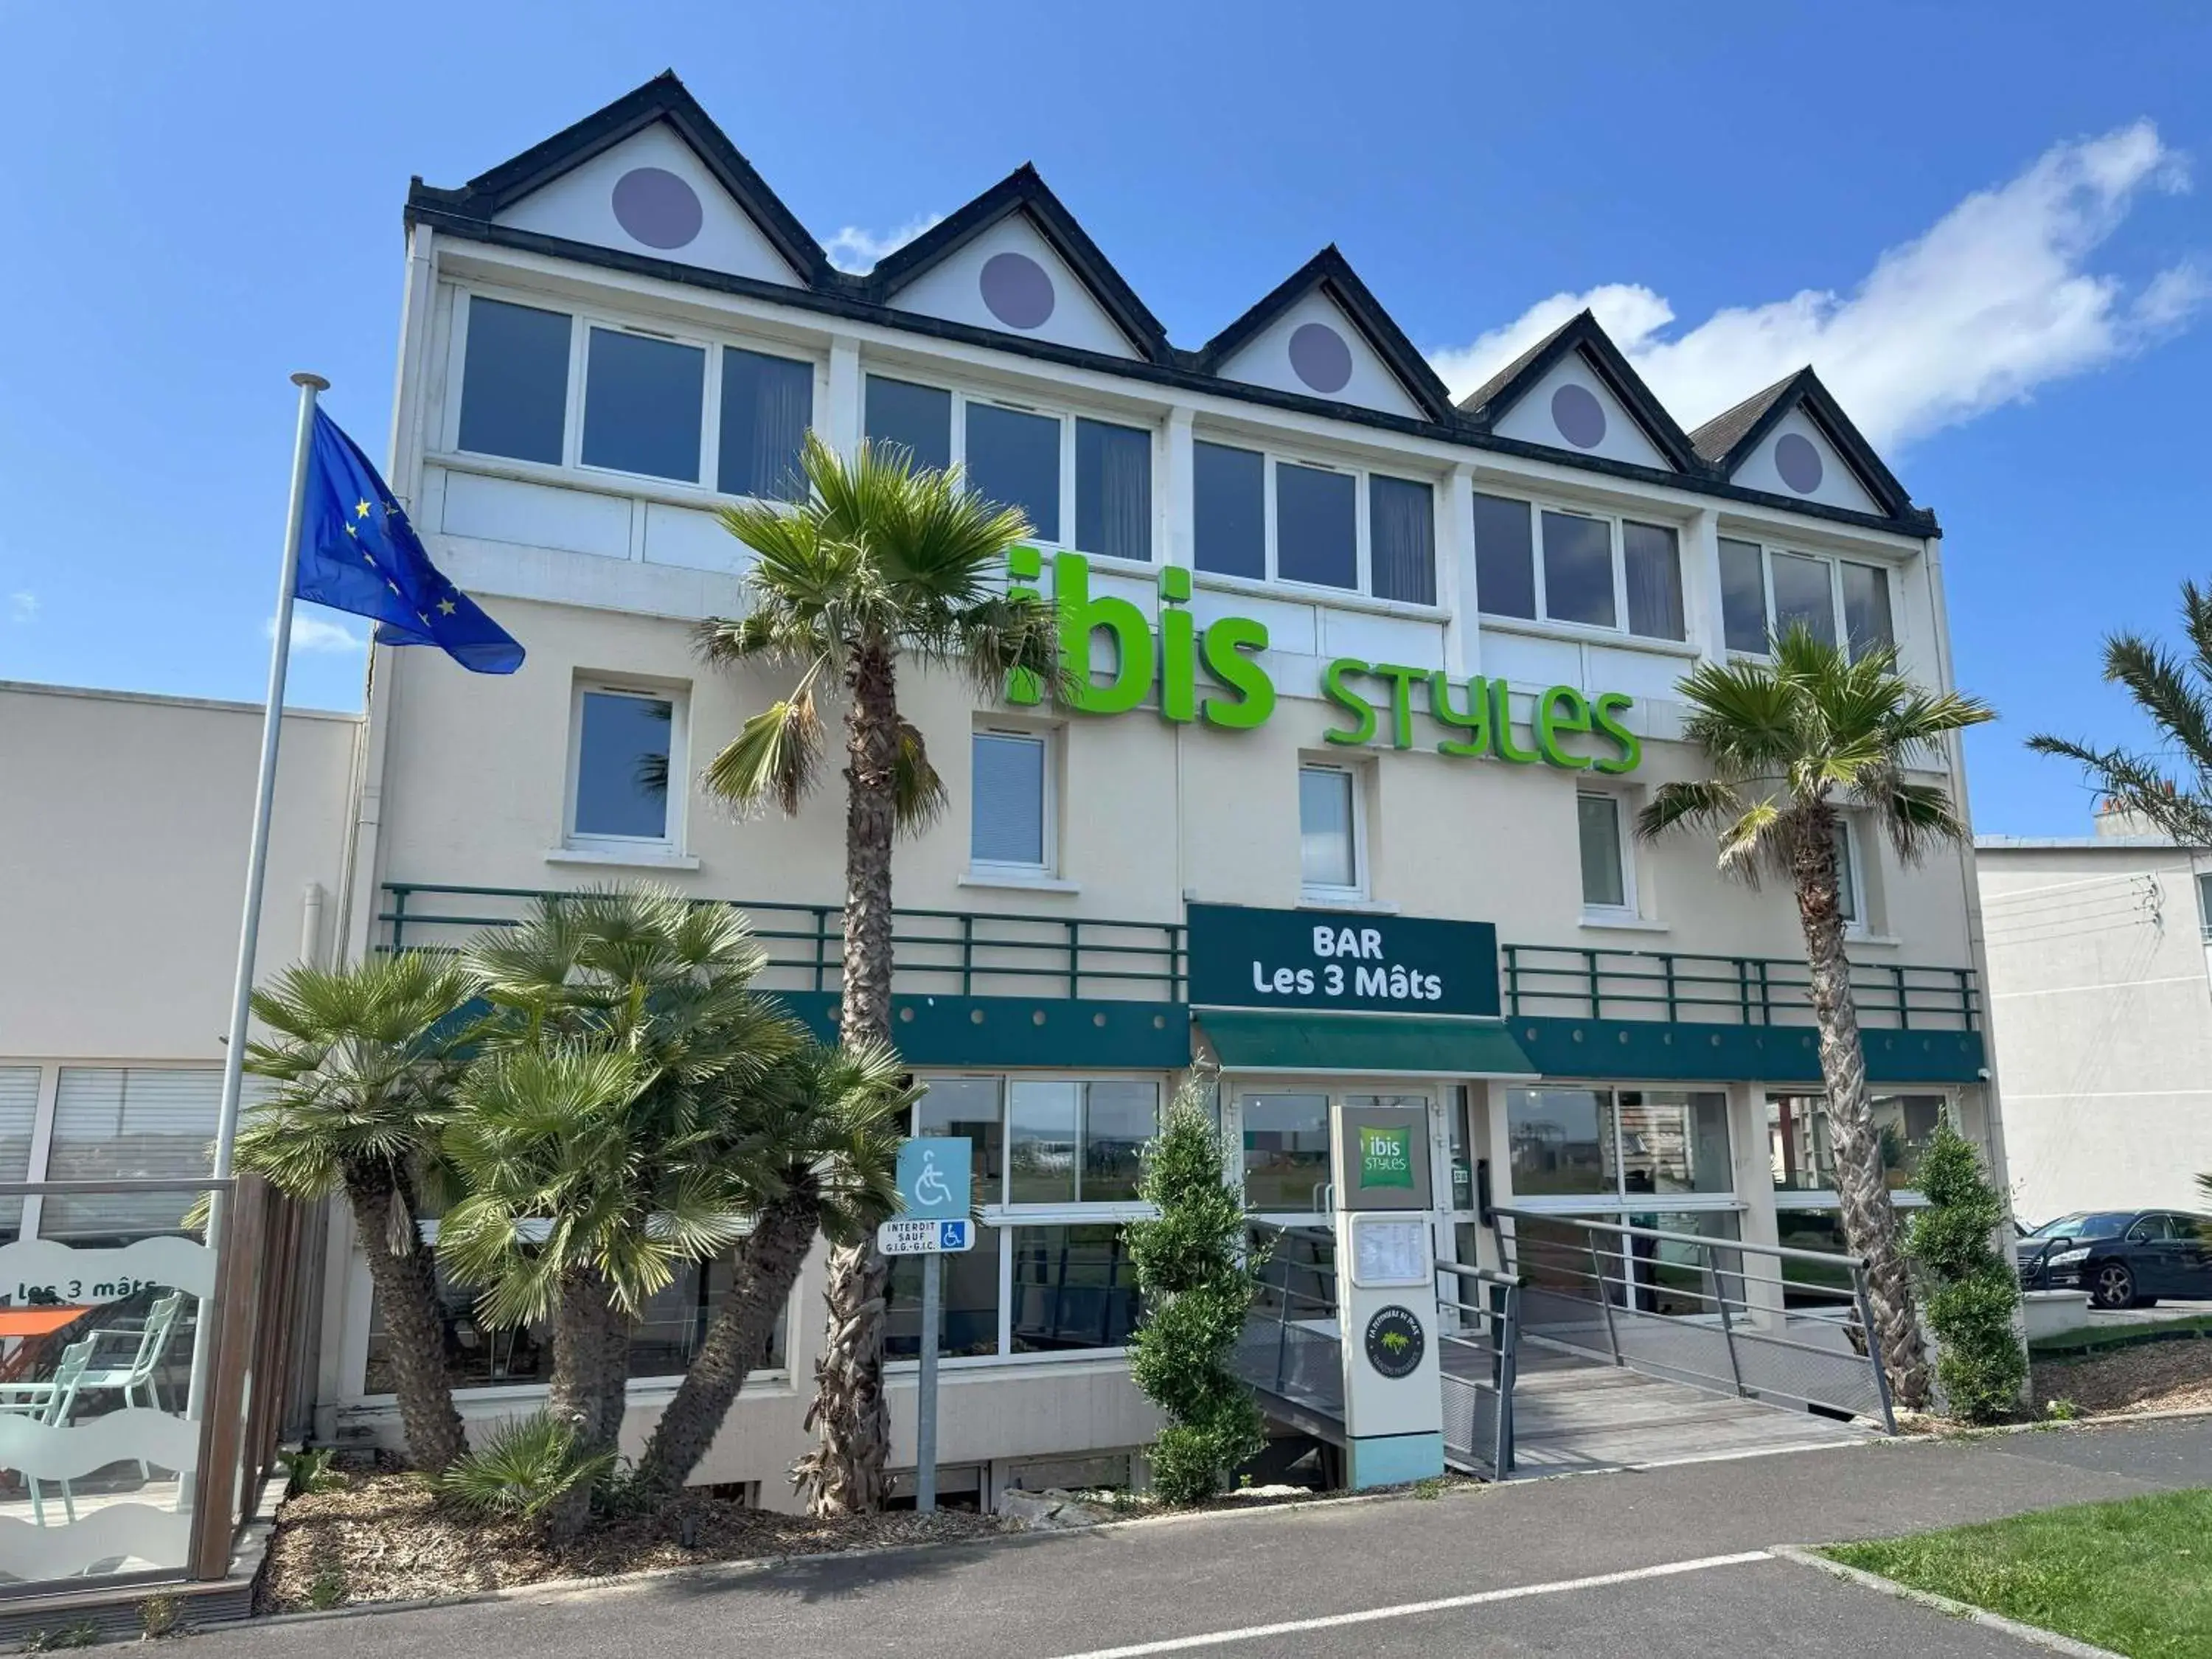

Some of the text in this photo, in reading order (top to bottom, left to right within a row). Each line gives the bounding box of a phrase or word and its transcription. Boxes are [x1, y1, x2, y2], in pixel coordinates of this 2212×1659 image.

[1007, 545, 1276, 729] ibis
[1312, 925, 1384, 959] BAR
[1253, 961, 1442, 1001] Les 3 Mâts
[1370, 1136, 1400, 1156] ibis
[887, 1221, 936, 1232] INTERDIT
[898, 1231, 925, 1242] SAUF
[67, 1279, 83, 1298] 3
